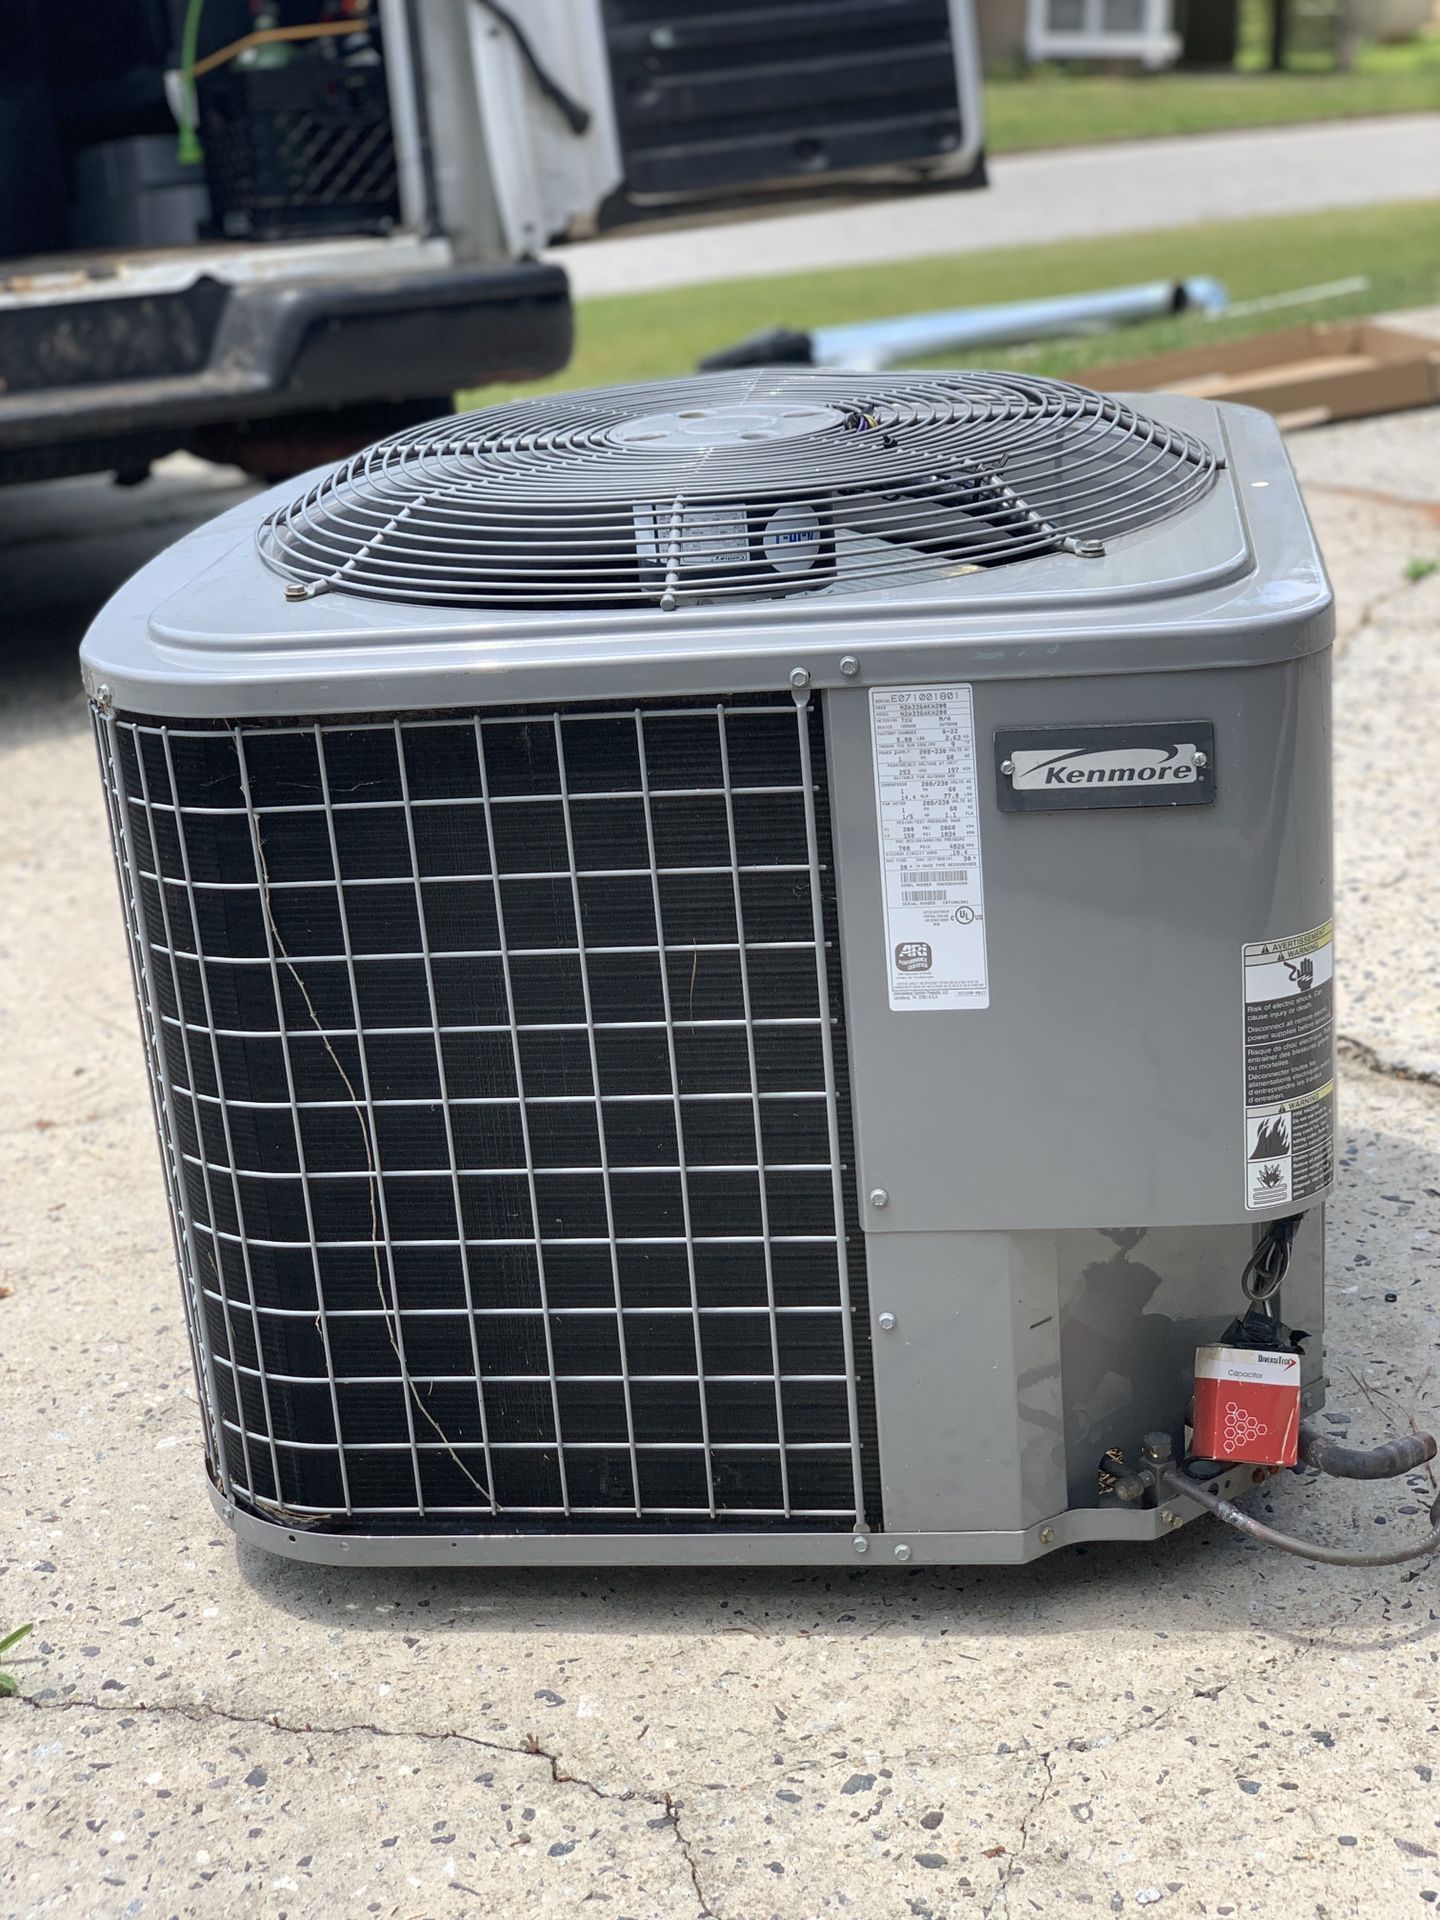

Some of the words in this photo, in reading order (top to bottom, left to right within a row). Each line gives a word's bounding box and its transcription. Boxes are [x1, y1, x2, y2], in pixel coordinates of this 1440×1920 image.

[891, 692, 958, 703] E071001801
[1045, 765, 1192, 784] Kenmore
[959, 911, 969, 920] UL
[1273, 927, 1326, 951] AVERTISSEMENT
[1287, 942, 1319, 957] WARNING
[1247, 1013, 1268, 1021] cause
[1270, 1010, 1287, 1018] injury
[1248, 1023, 1285, 1033] Disconnect
[1248, 1033, 1269, 1043] power
[1271, 1028, 1296, 1038] supplies
[1248, 1048, 1271, 1056] Risque
[1283, 1042, 1298, 1050] choc
[1248, 1076, 1291, 1088] alimentations
[1289, 1093, 1319, 1109] WARNING
[1228, 1369, 1263, 1379] Capacitor
